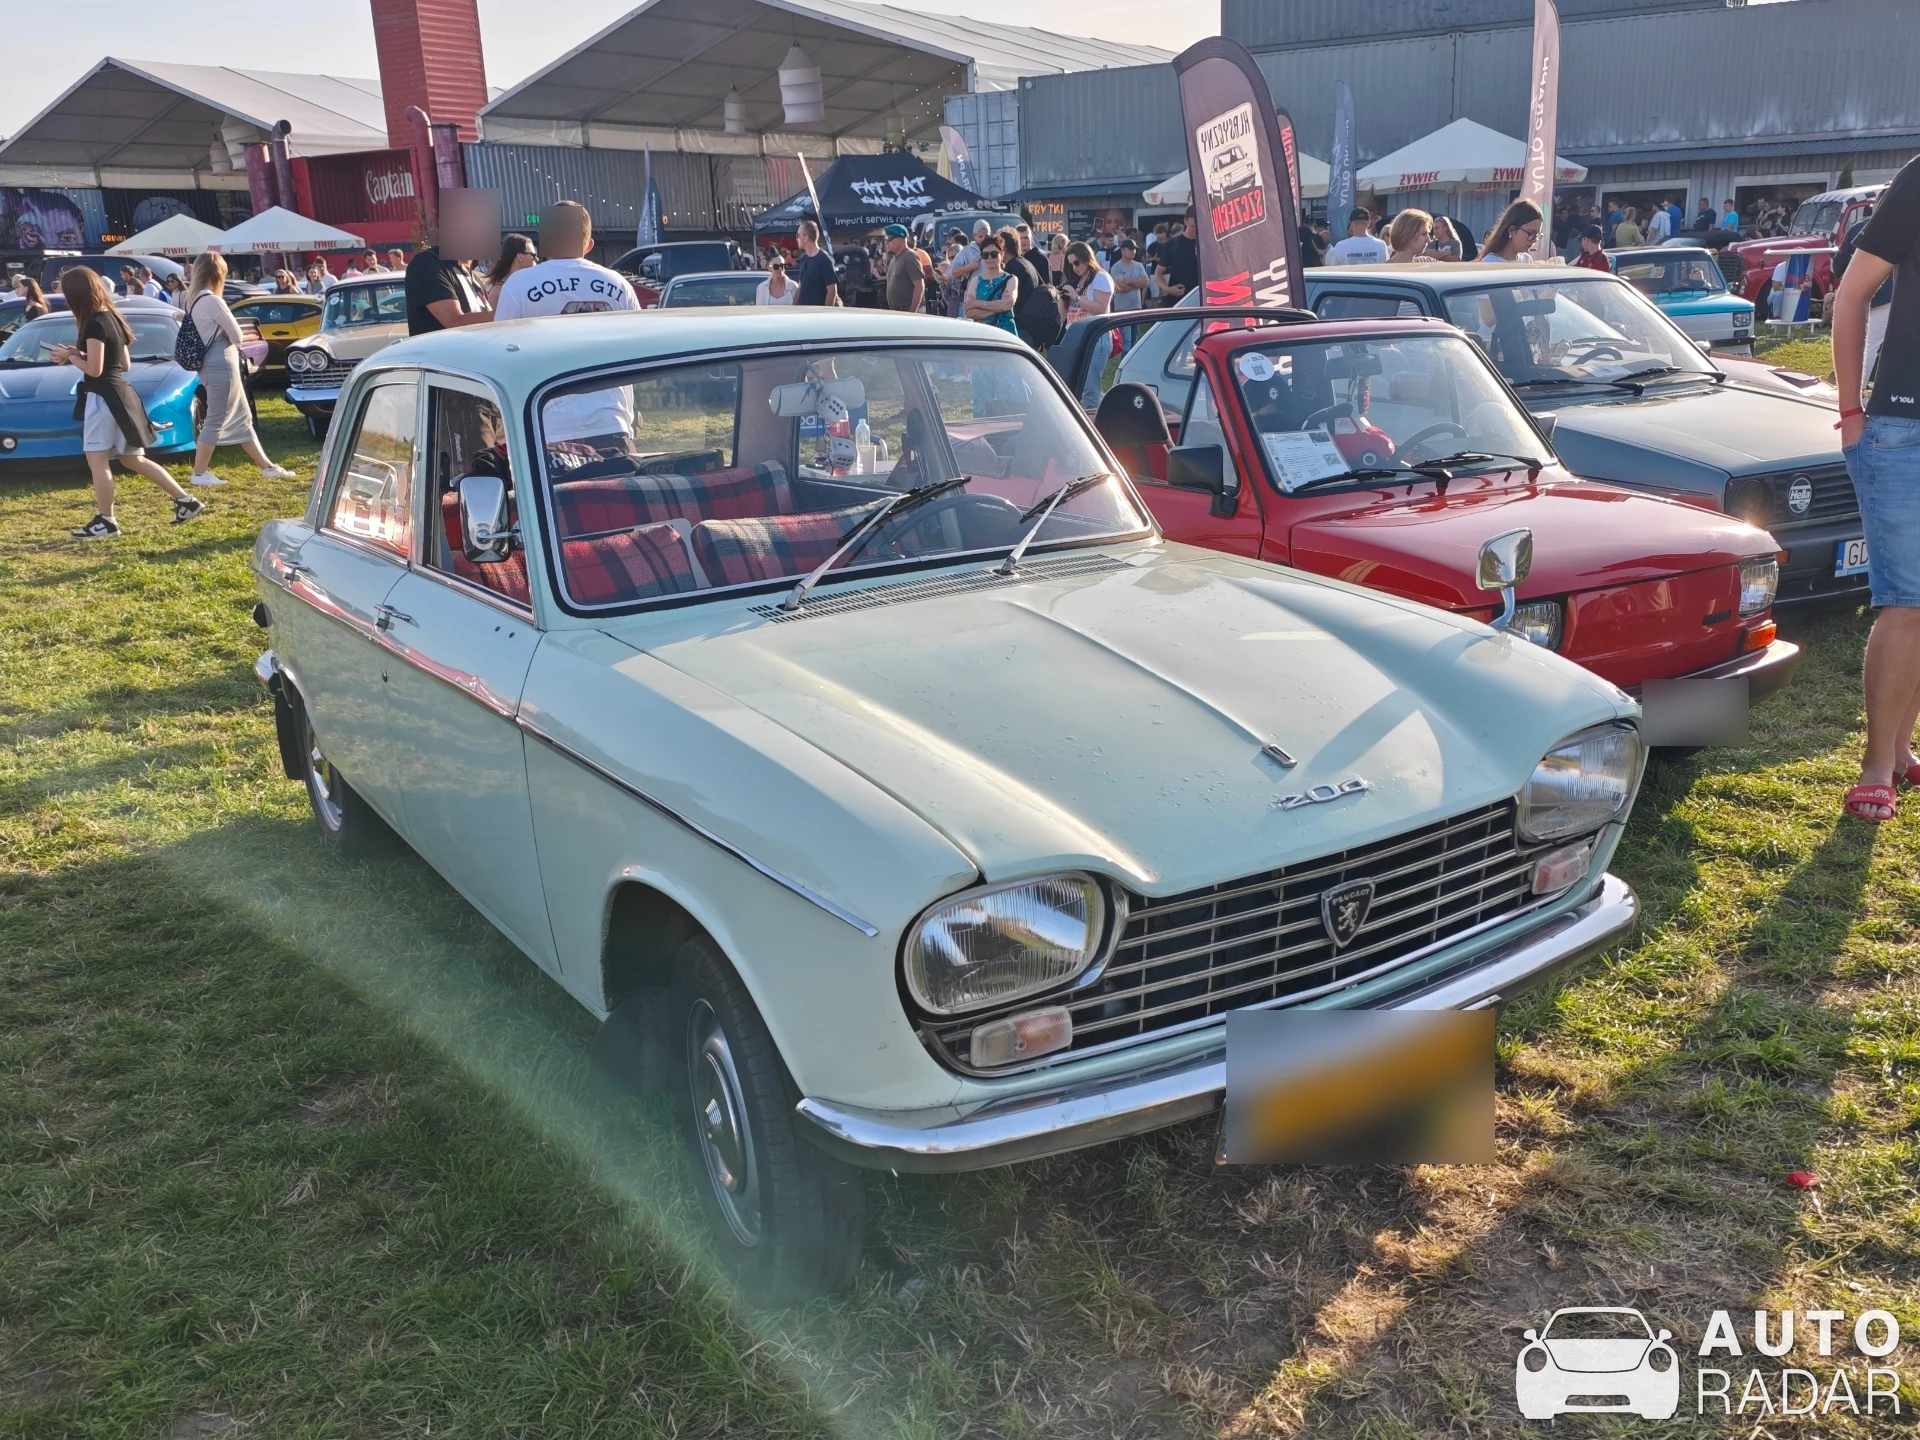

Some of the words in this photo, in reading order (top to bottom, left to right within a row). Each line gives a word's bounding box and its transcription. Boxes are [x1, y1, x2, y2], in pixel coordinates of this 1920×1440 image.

[1400, 171, 1440, 185] ŻYWIEC
[1492, 168, 1526, 181] ŻYWI
[365, 165, 415, 205] Captain
[851, 178, 886, 195] FAT
[888, 176, 926, 195] RAT
[861, 195, 935, 209] GARAGE
[1029, 203, 1063, 215] FRYTKI
[865, 214, 893, 224] serwis
[527, 278, 580, 302] GOLF
[590, 279, 624, 302] GTI
[1790, 489, 1810, 500] Hella
[1280, 774, 1369, 811] 204
[1332, 889, 1371, 906] PEUGEOT
